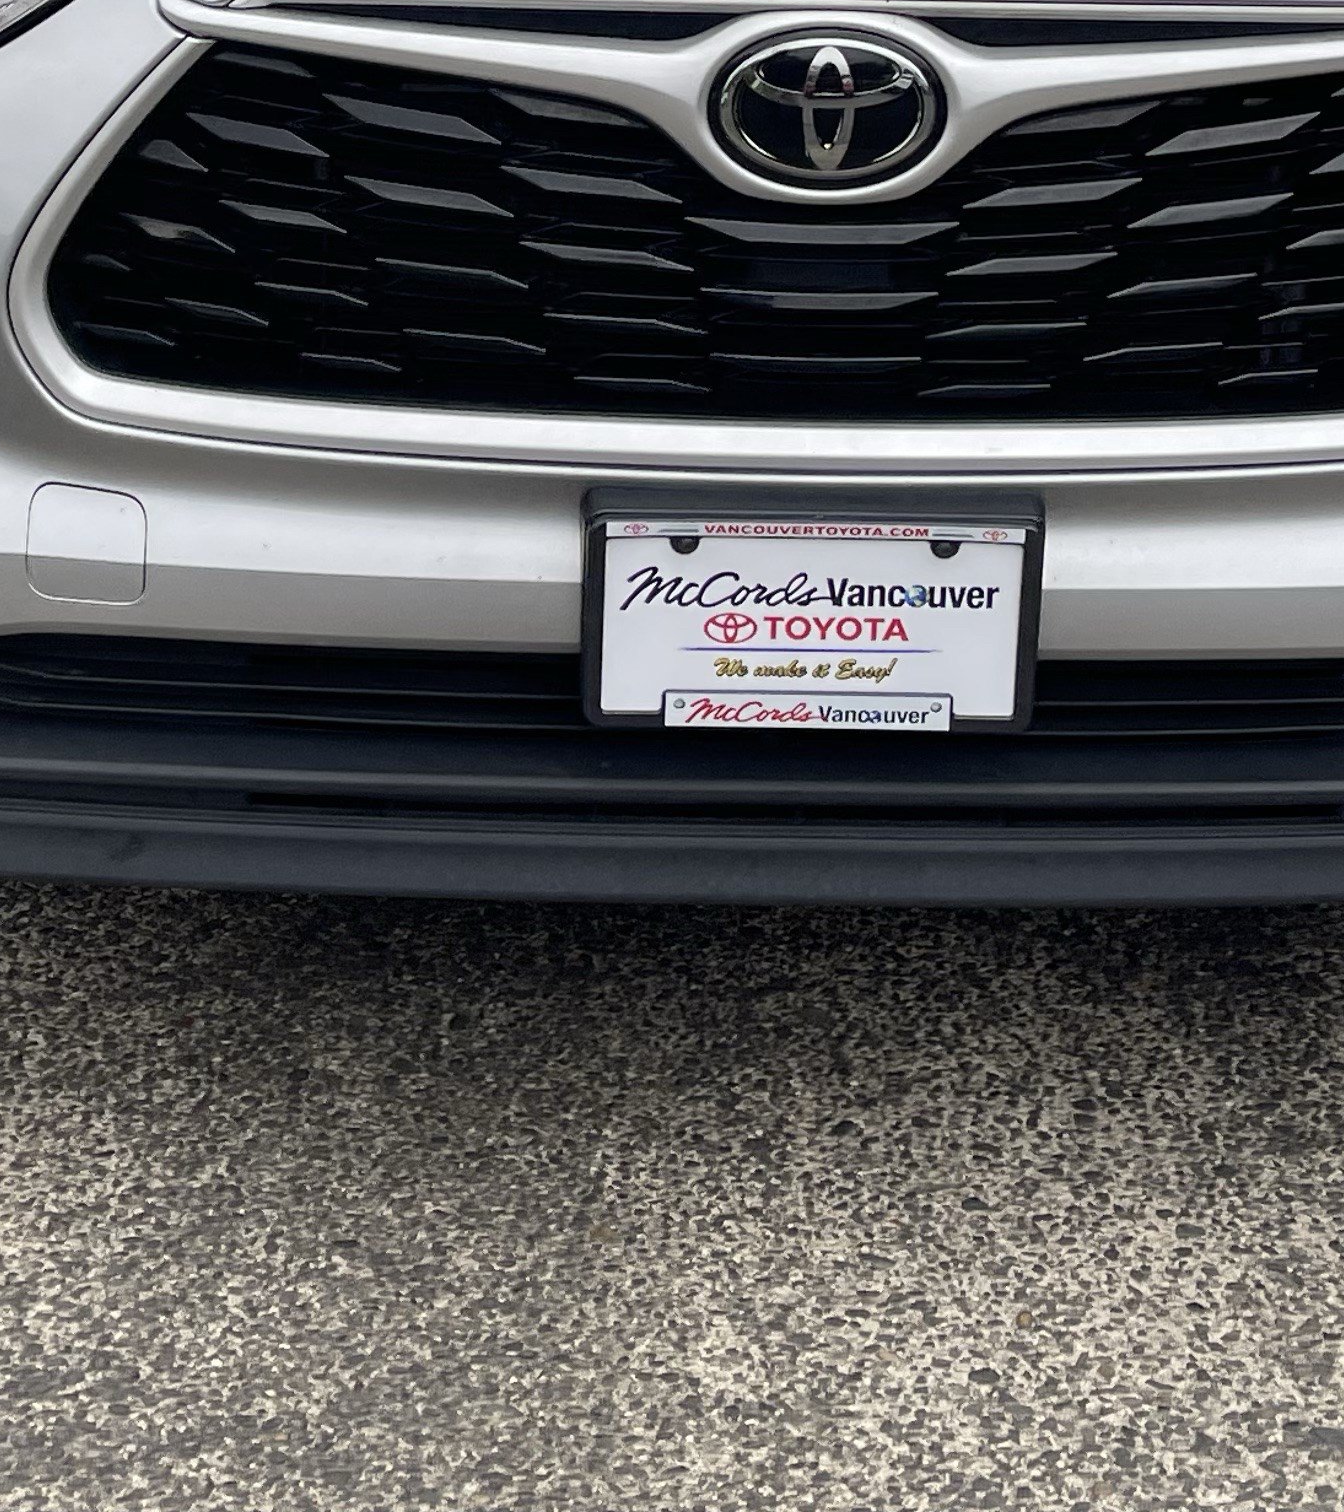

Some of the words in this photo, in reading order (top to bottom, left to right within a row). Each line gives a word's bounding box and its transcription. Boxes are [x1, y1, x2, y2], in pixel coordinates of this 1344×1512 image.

[704, 524, 930, 539] VANCOUVERTOYOTA.COM
[619, 566, 828, 611] McCords
[826, 577, 1000, 609] Vancouver
[761, 616, 909, 642] TOYOTA
[713, 657, 749, 677] We
[753, 659, 807, 678] make
[812, 663, 831, 678] it
[834, 657, 898, 684] Easy!
[684, 697, 816, 724] McCords
[818, 705, 930, 725] Vancouver
